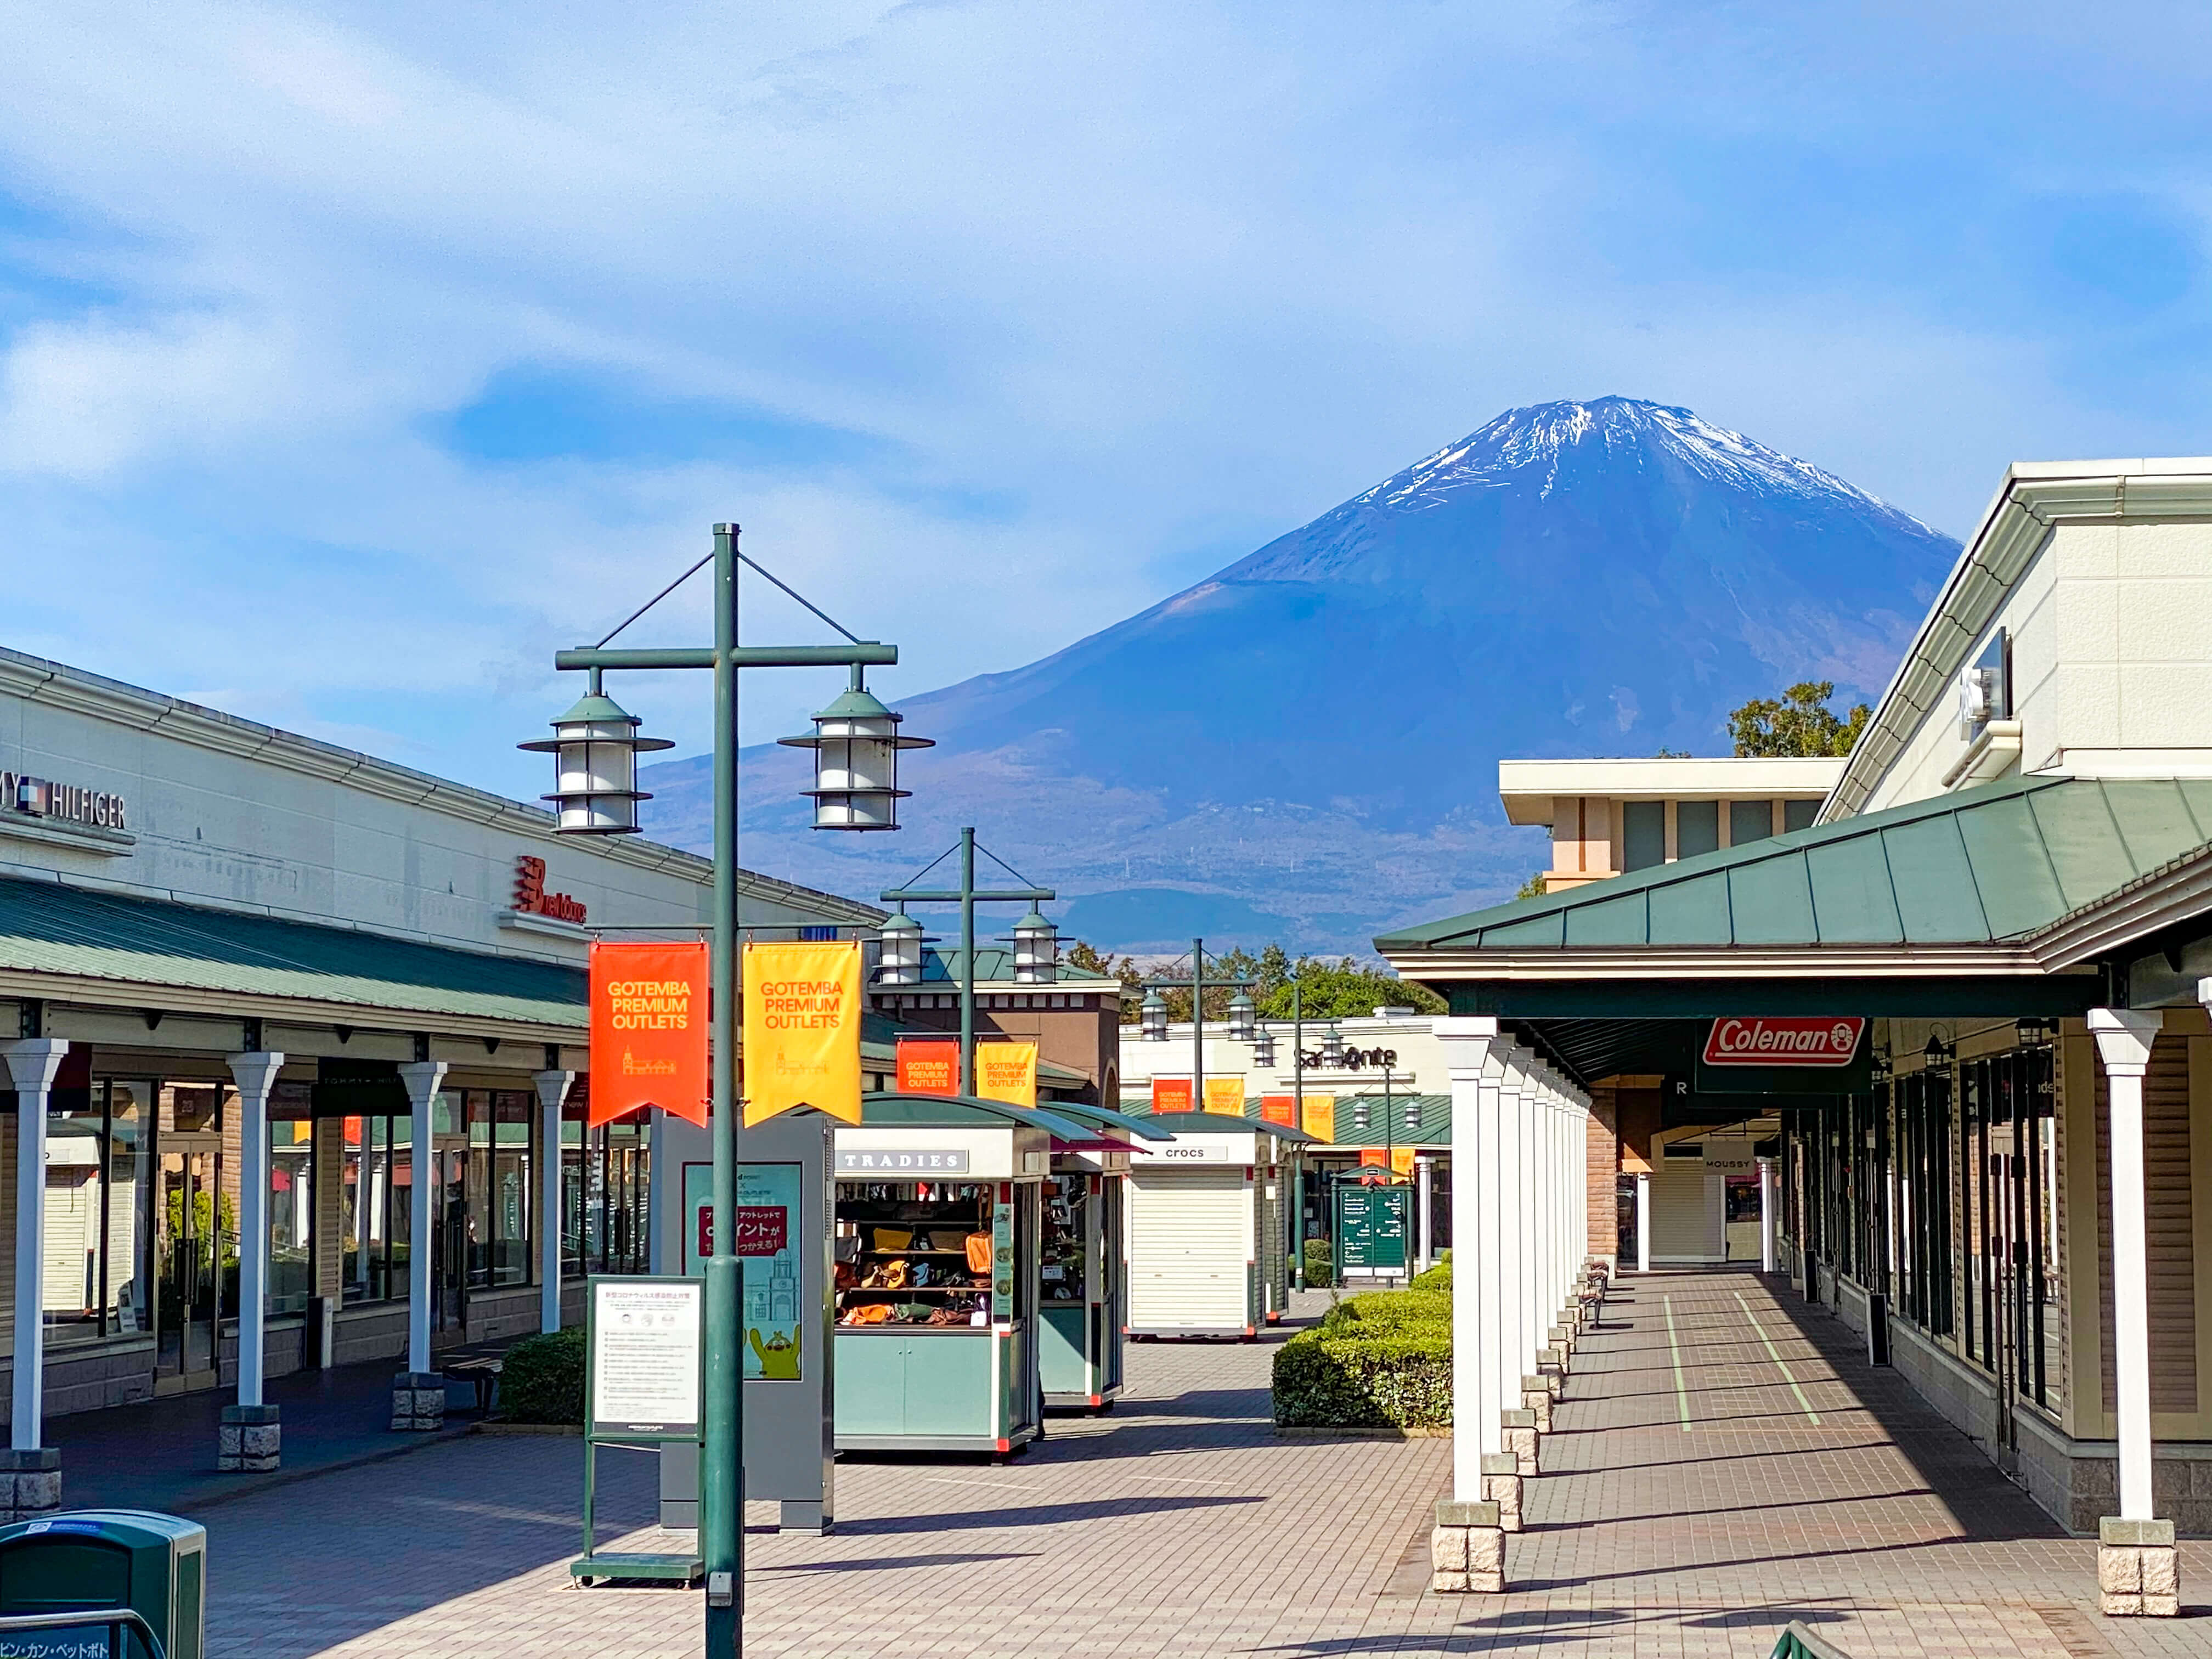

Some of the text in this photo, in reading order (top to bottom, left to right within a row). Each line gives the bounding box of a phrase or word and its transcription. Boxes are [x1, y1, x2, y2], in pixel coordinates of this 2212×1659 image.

[52, 782, 126, 828] HILFIGER
[608, 981, 691, 996] GOTEMBA
[761, 981, 843, 996] GOTEMBA
[612, 998, 687, 1013] PREMIUM
[765, 998, 839, 1013] PREMIUM
[612, 1014, 687, 1029] OUTLETS
[765, 1014, 839, 1029] OUTLETS
[1719, 1020, 1828, 1052] Coleman
[906, 1062, 949, 1070] GOTEMBA
[909, 1079, 948, 1087] OUTLETS
[988, 1079, 1026, 1087] OUTLETS
[1166, 1148, 1204, 1158] crocs
[845, 1155, 957, 1167] TRADIES
